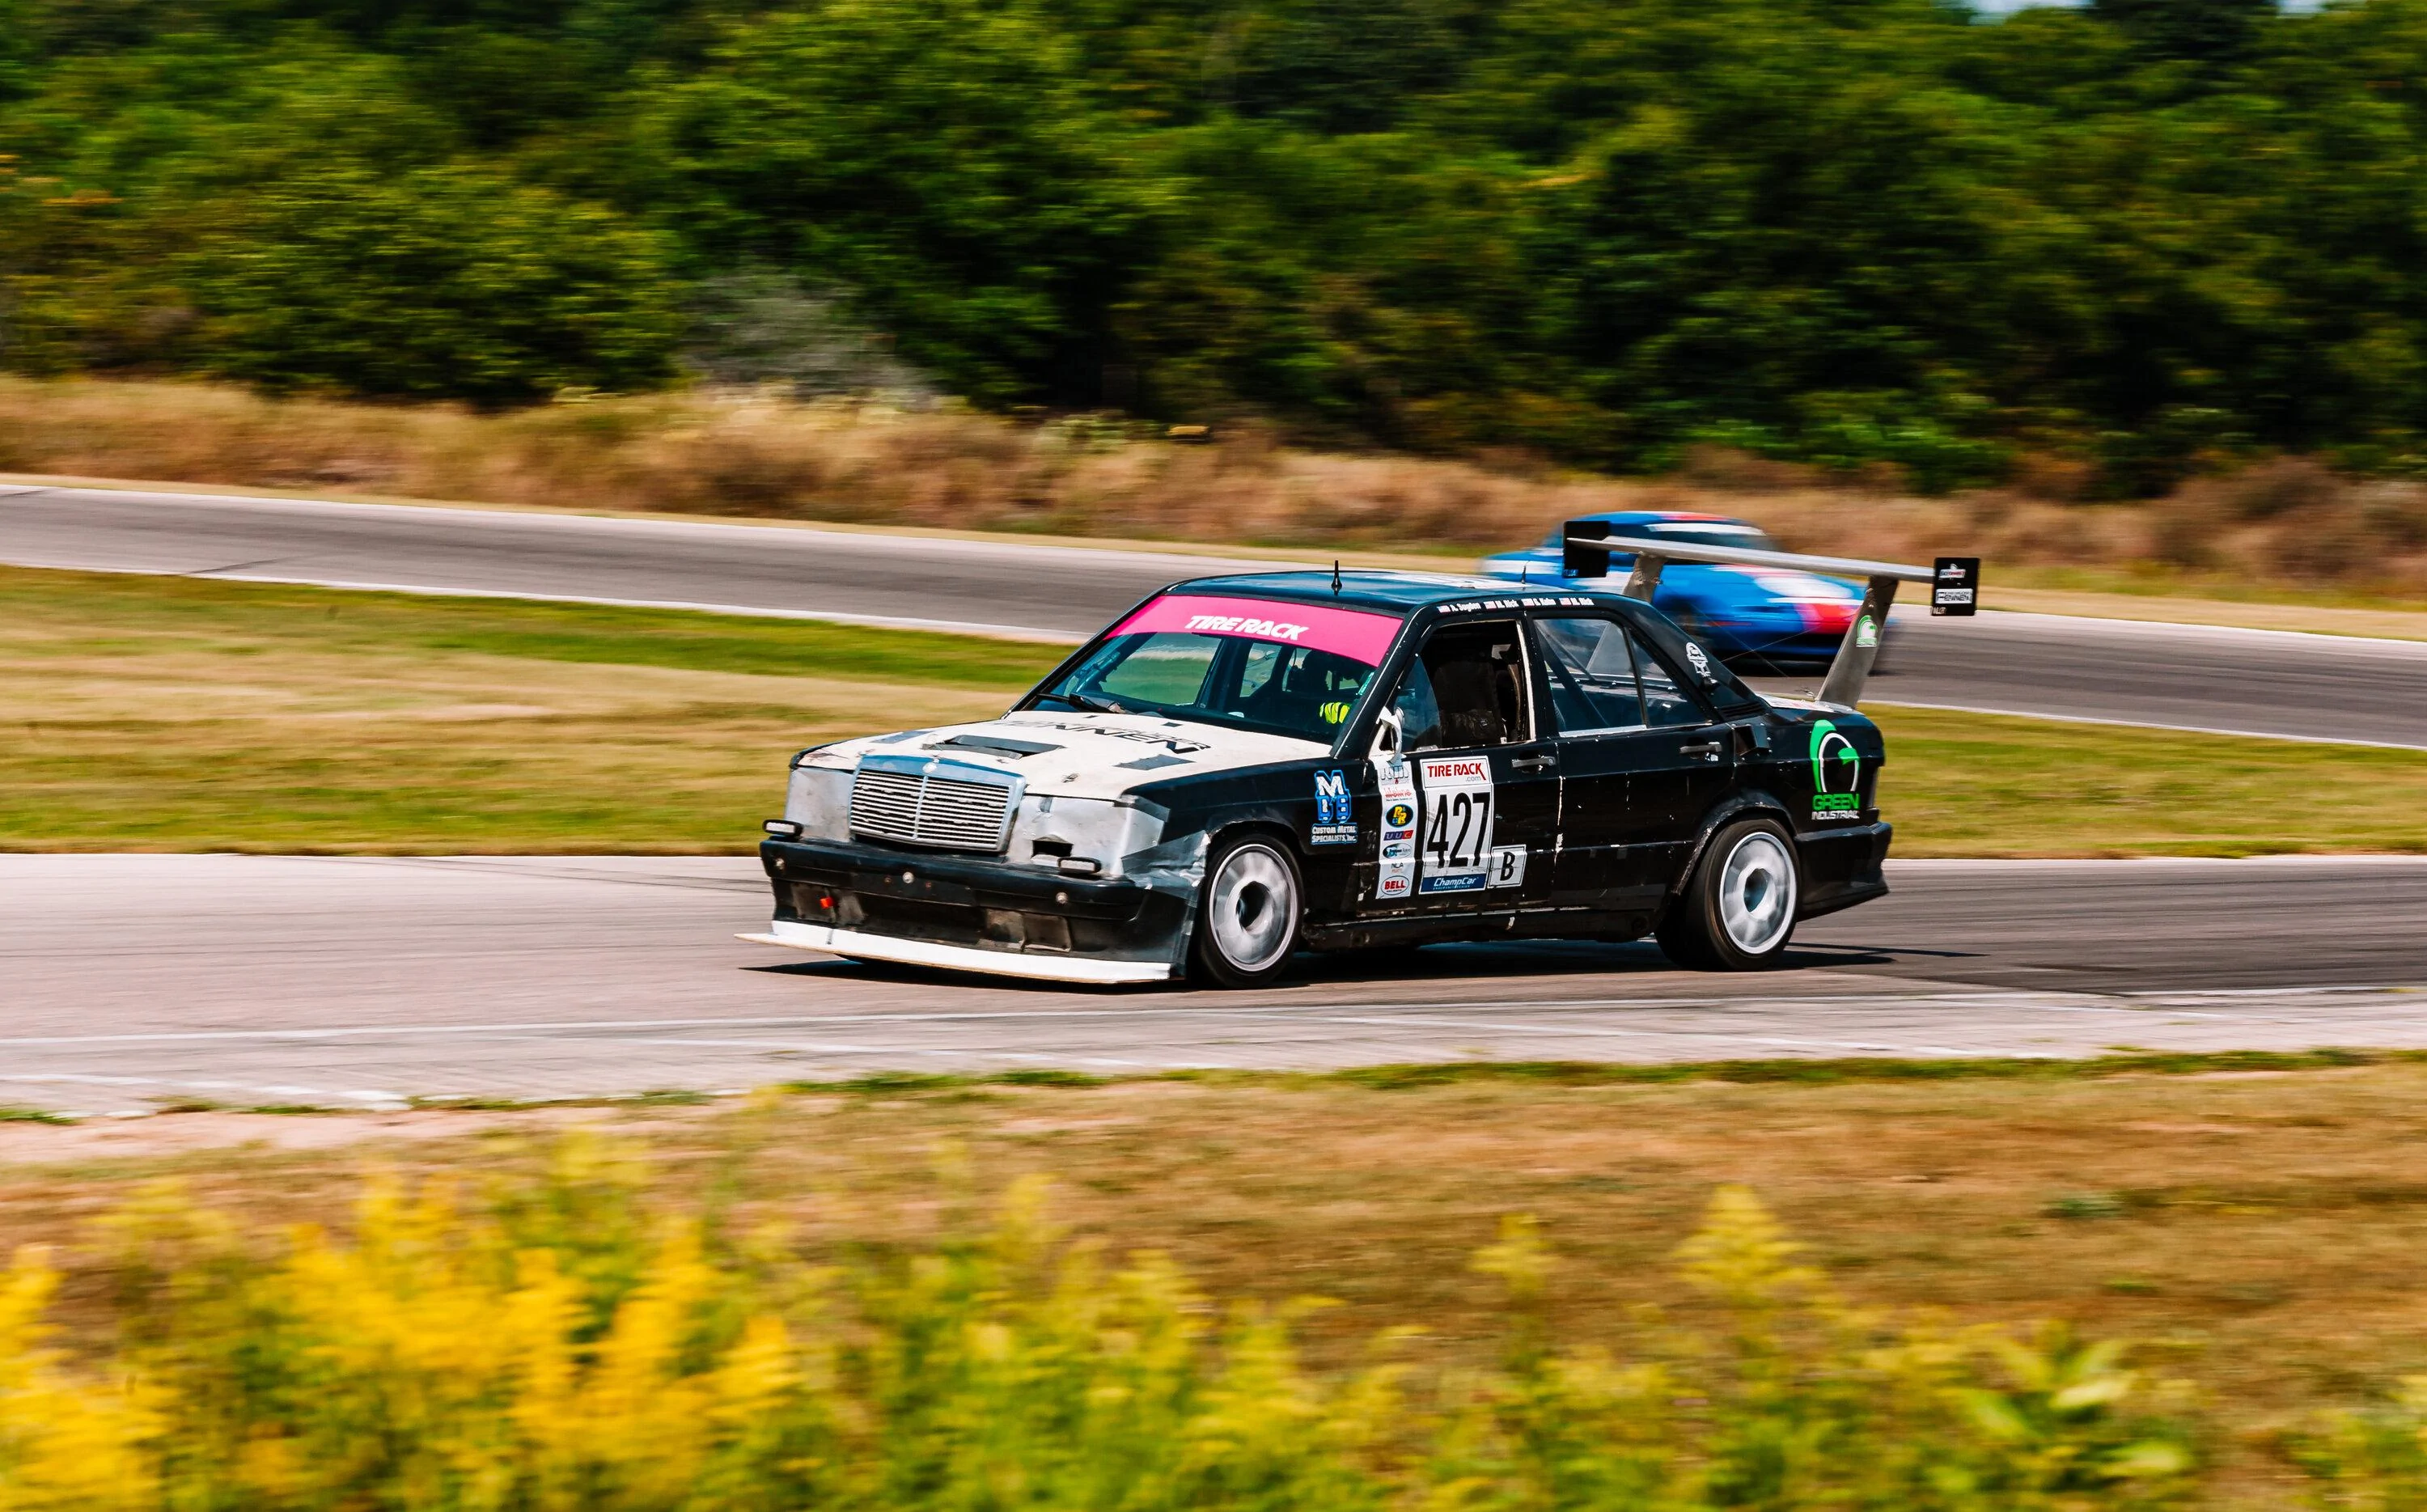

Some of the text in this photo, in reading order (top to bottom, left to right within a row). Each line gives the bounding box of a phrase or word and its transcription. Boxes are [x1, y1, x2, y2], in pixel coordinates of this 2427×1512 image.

[1184, 615, 1310, 641] TIRE RACK
[1427, 764, 1452, 777] TIRE
[1454, 763, 1486, 781] RACK
[1813, 794, 1859, 810] GREEN
[1311, 826, 1336, 834] CUSTOM
[1386, 832, 1412, 840] UUC
[1426, 792, 1491, 869] 427
[1500, 851, 1516, 882] B
[1384, 879, 1406, 890] BELL
[1434, 877, 1477, 888] ChampCar
